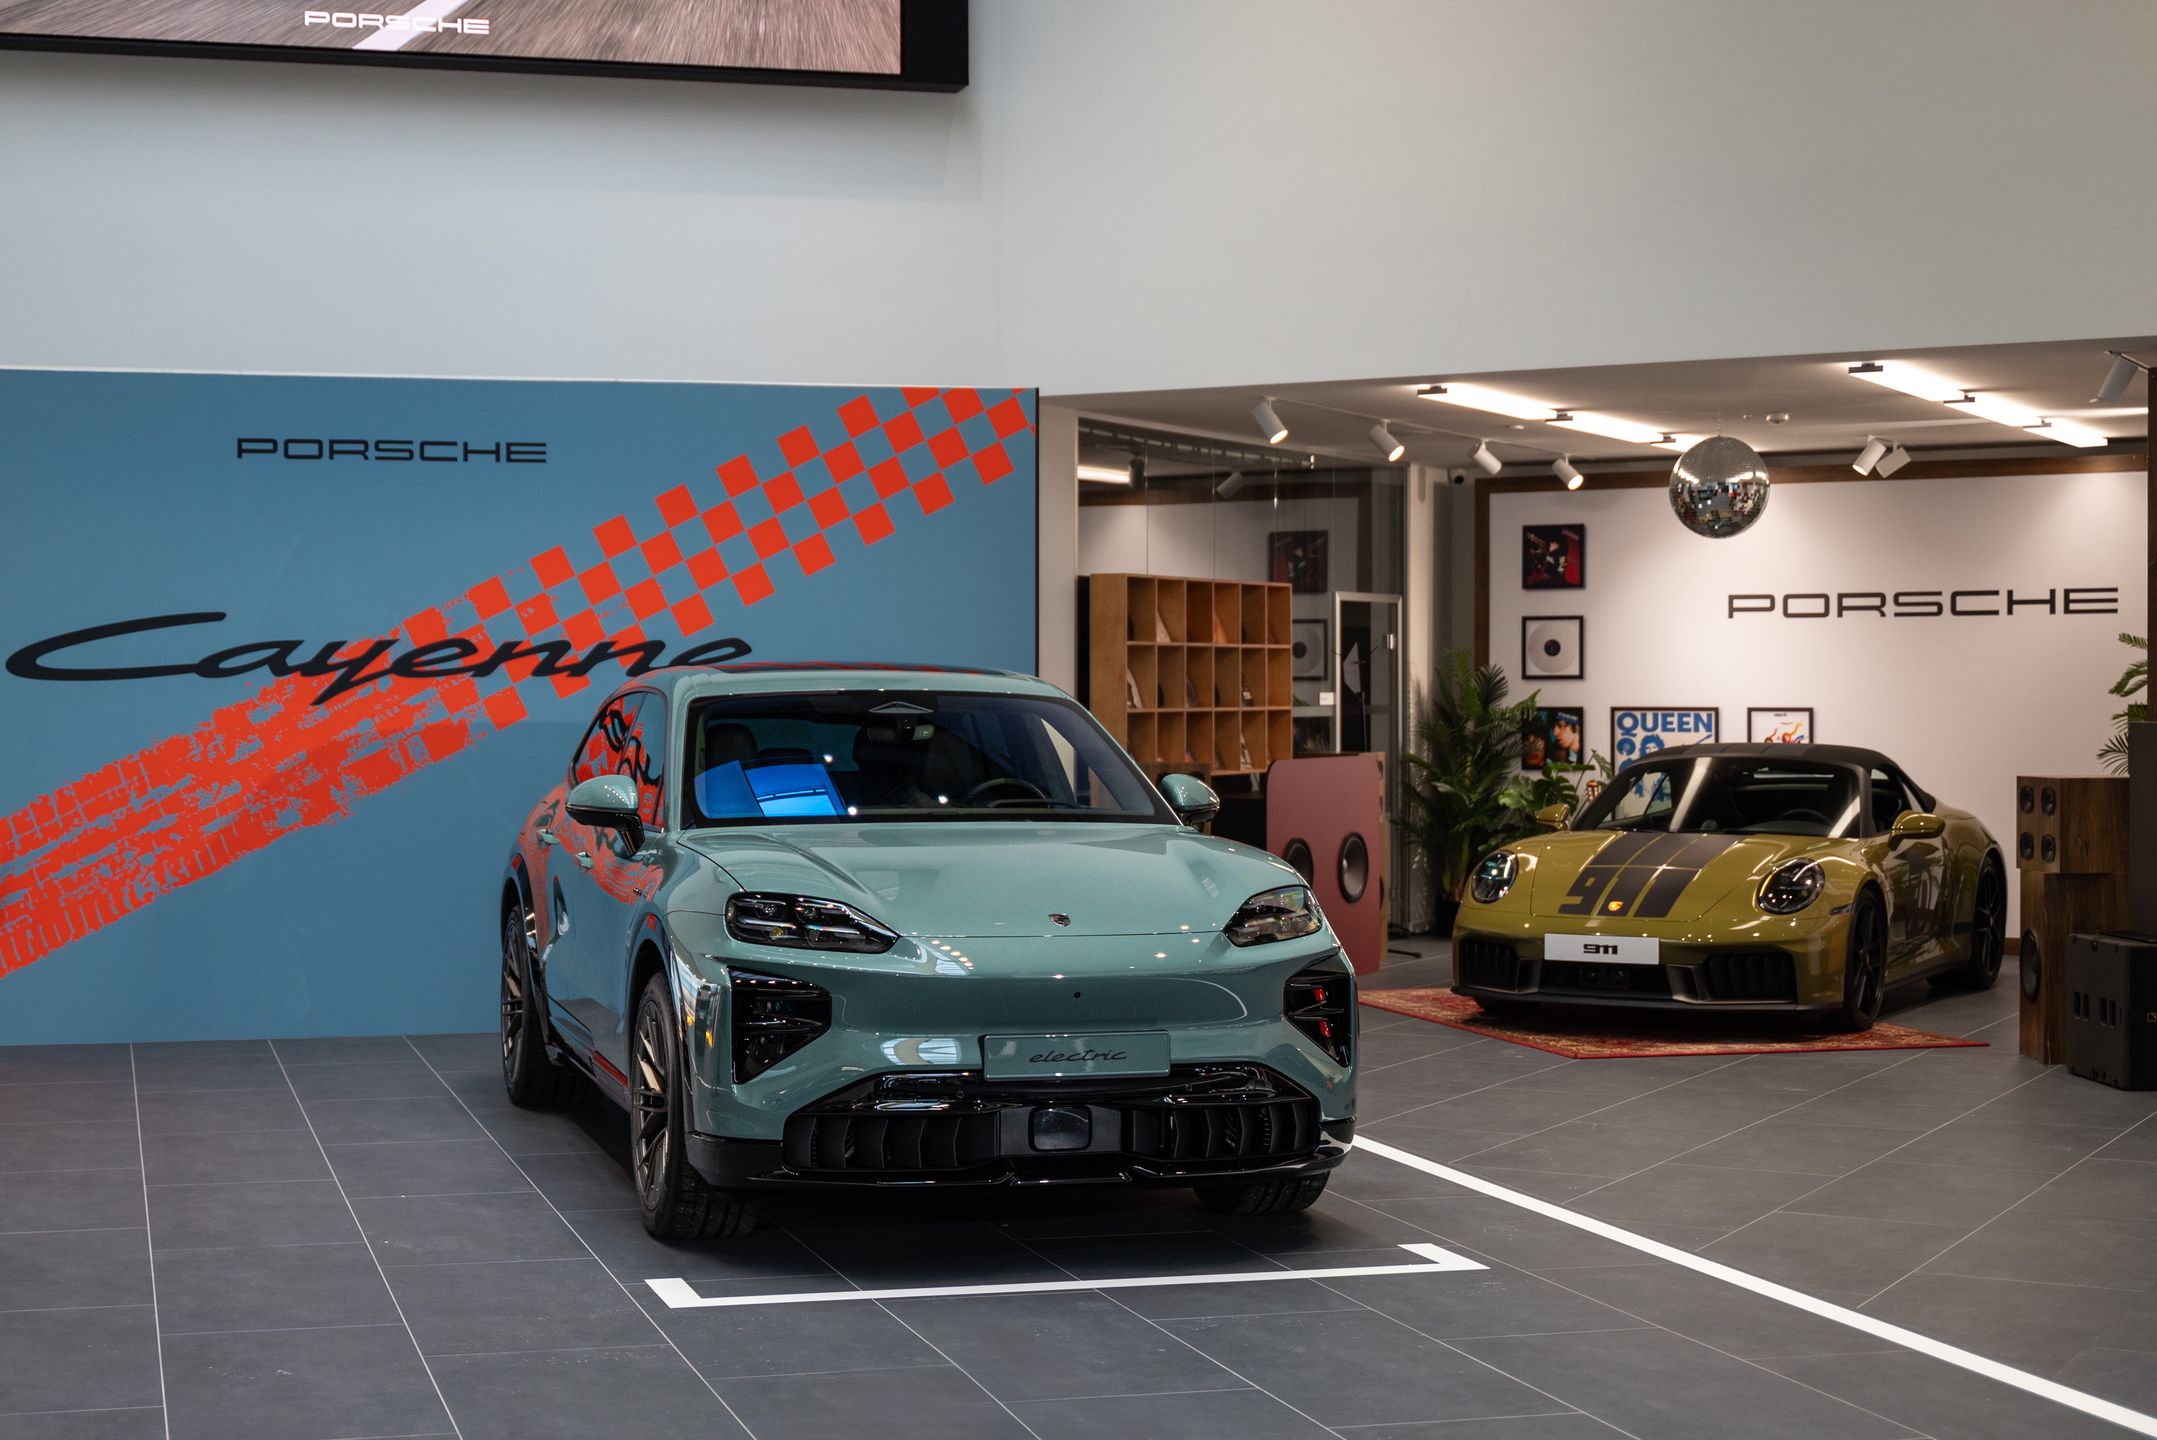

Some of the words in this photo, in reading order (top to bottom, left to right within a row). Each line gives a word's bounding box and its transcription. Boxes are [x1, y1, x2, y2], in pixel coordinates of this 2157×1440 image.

[304, 10, 490, 35] PORSCHE
[236, 437, 547, 464] PORSCHE
[1727, 586, 2119, 619] PORSCHE
[5, 611, 752, 706] Cayenne
[1616, 711, 1713, 738] QUEEN
[1557, 866, 1702, 918] 911
[1583, 943, 1619, 955] 911
[1029, 1049, 1128, 1064] electric
